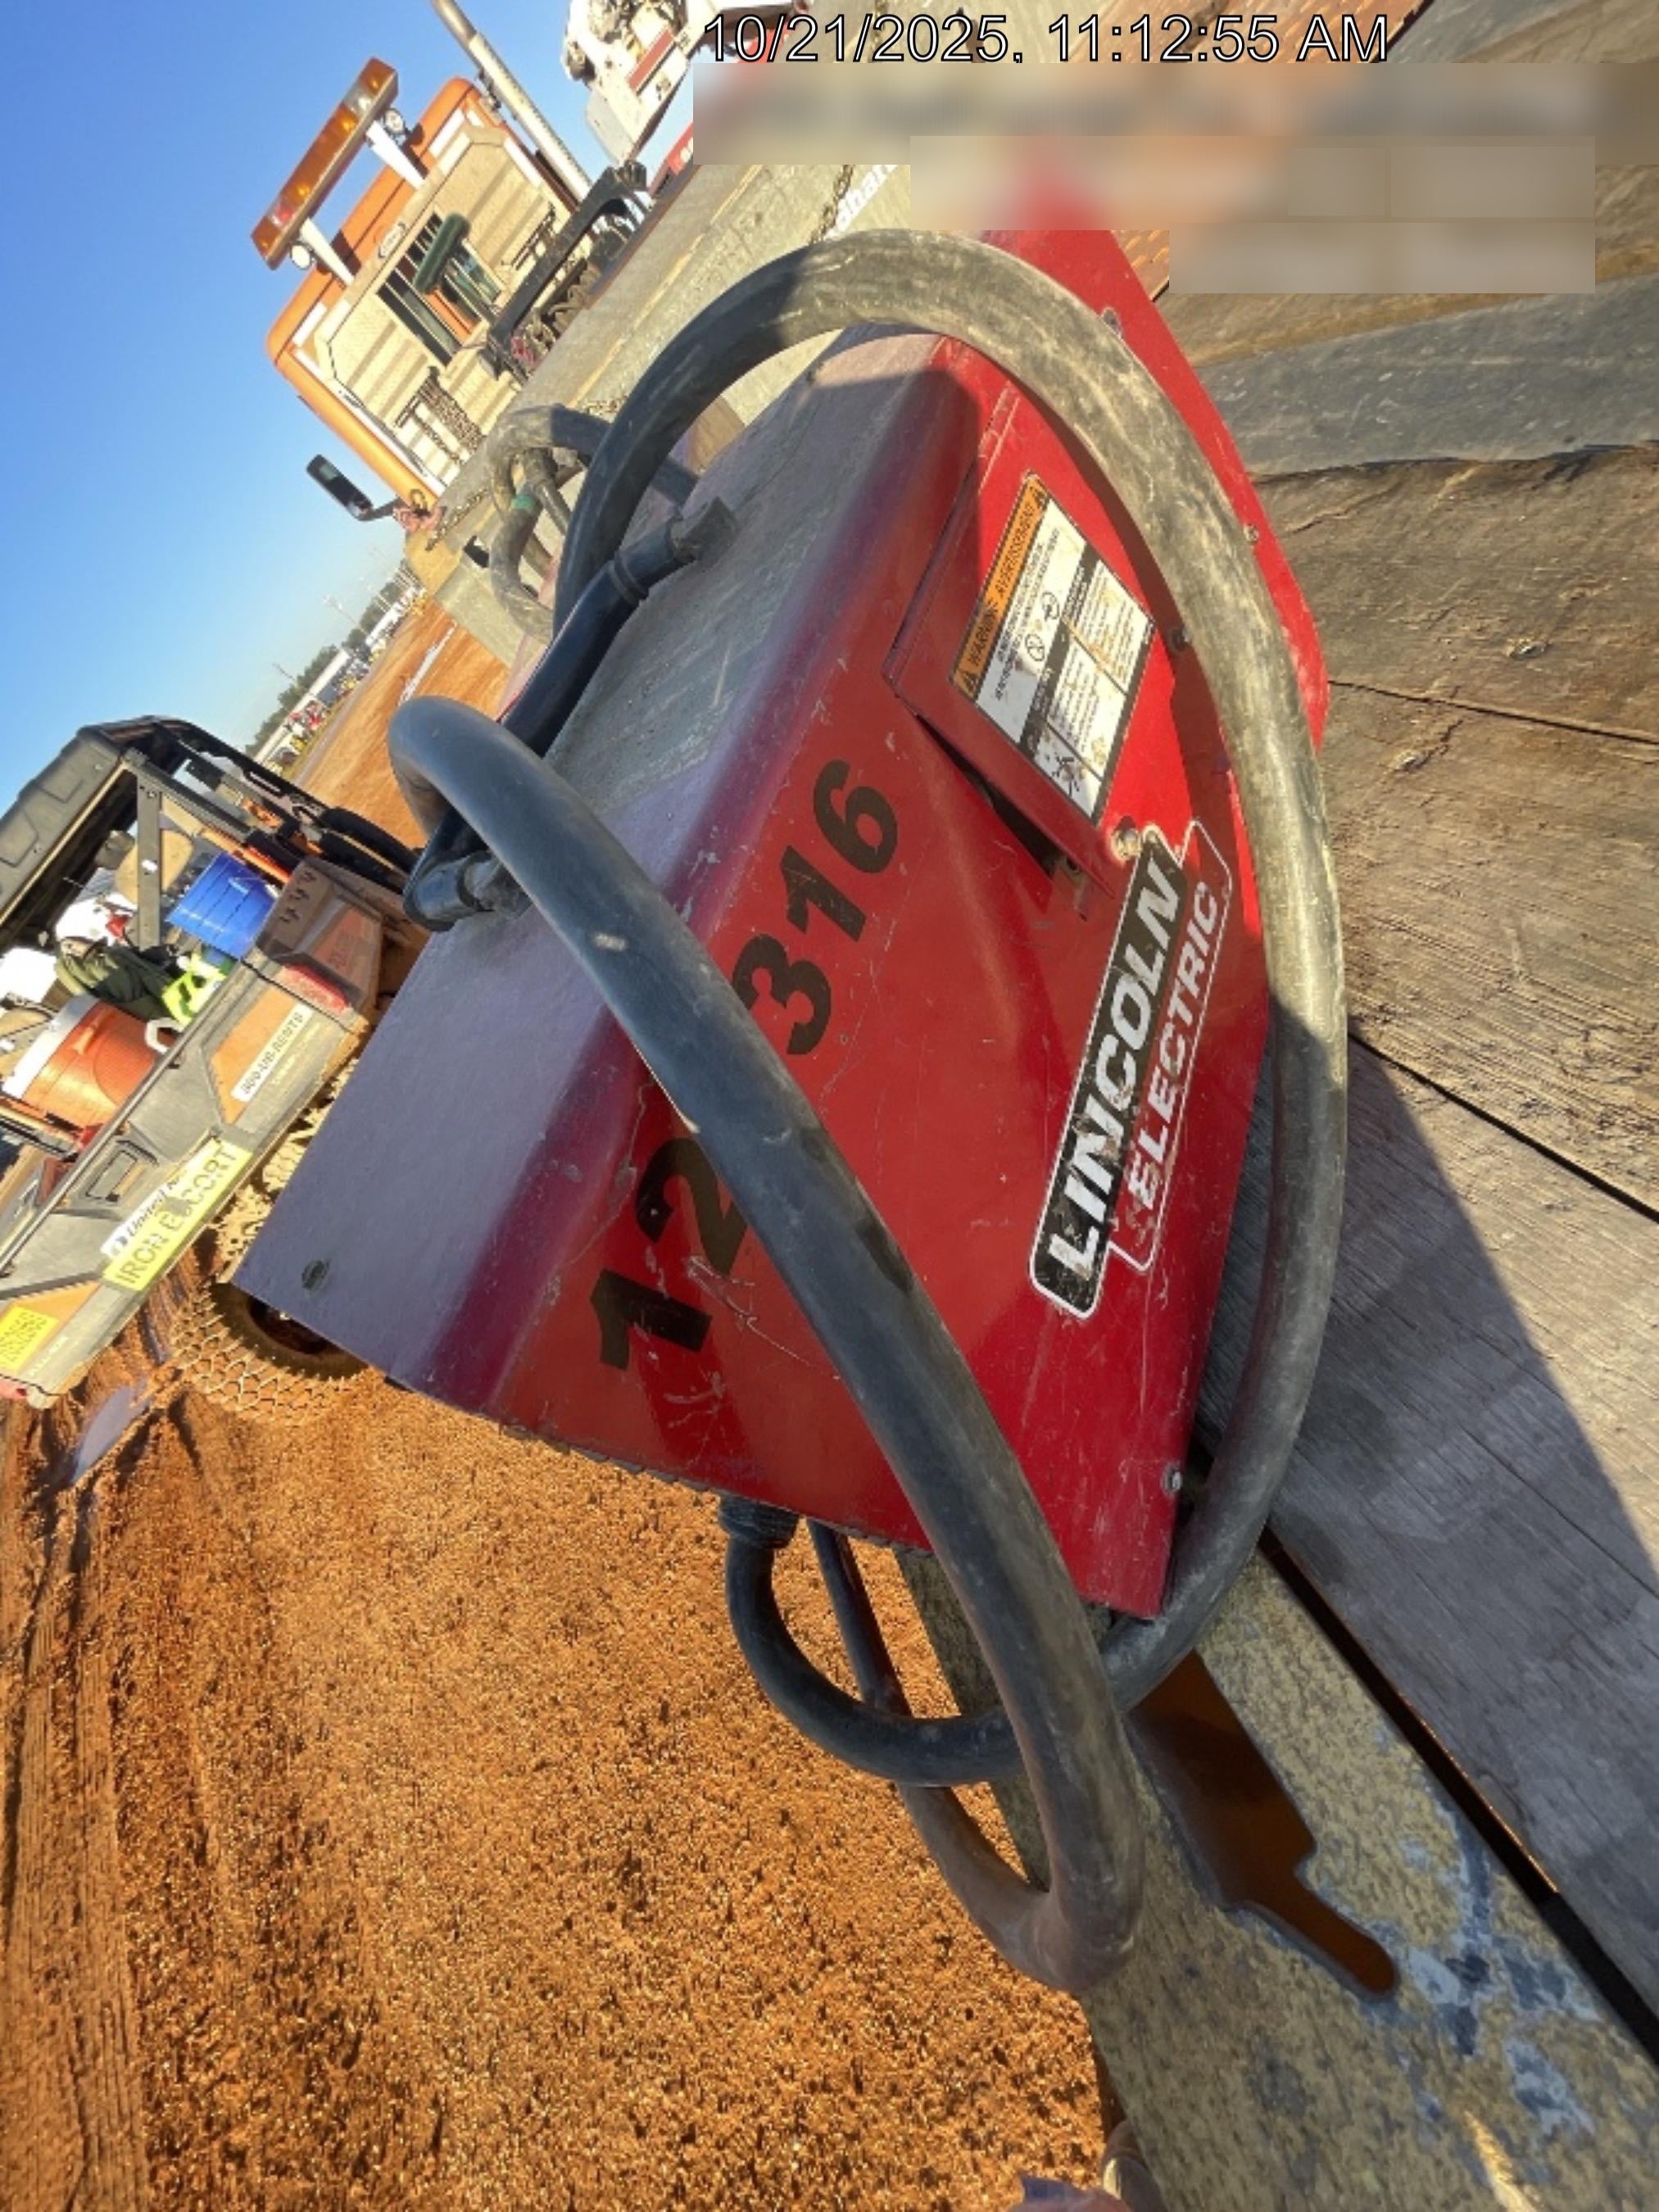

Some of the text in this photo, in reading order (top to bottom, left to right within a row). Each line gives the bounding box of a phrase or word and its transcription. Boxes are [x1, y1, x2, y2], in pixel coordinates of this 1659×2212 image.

[1049, 859, 1183, 1281] LINCOLN
[1127, 881, 1218, 1212] ELECTRIC
[116, 1146, 237, 1284] IRON ECORT
